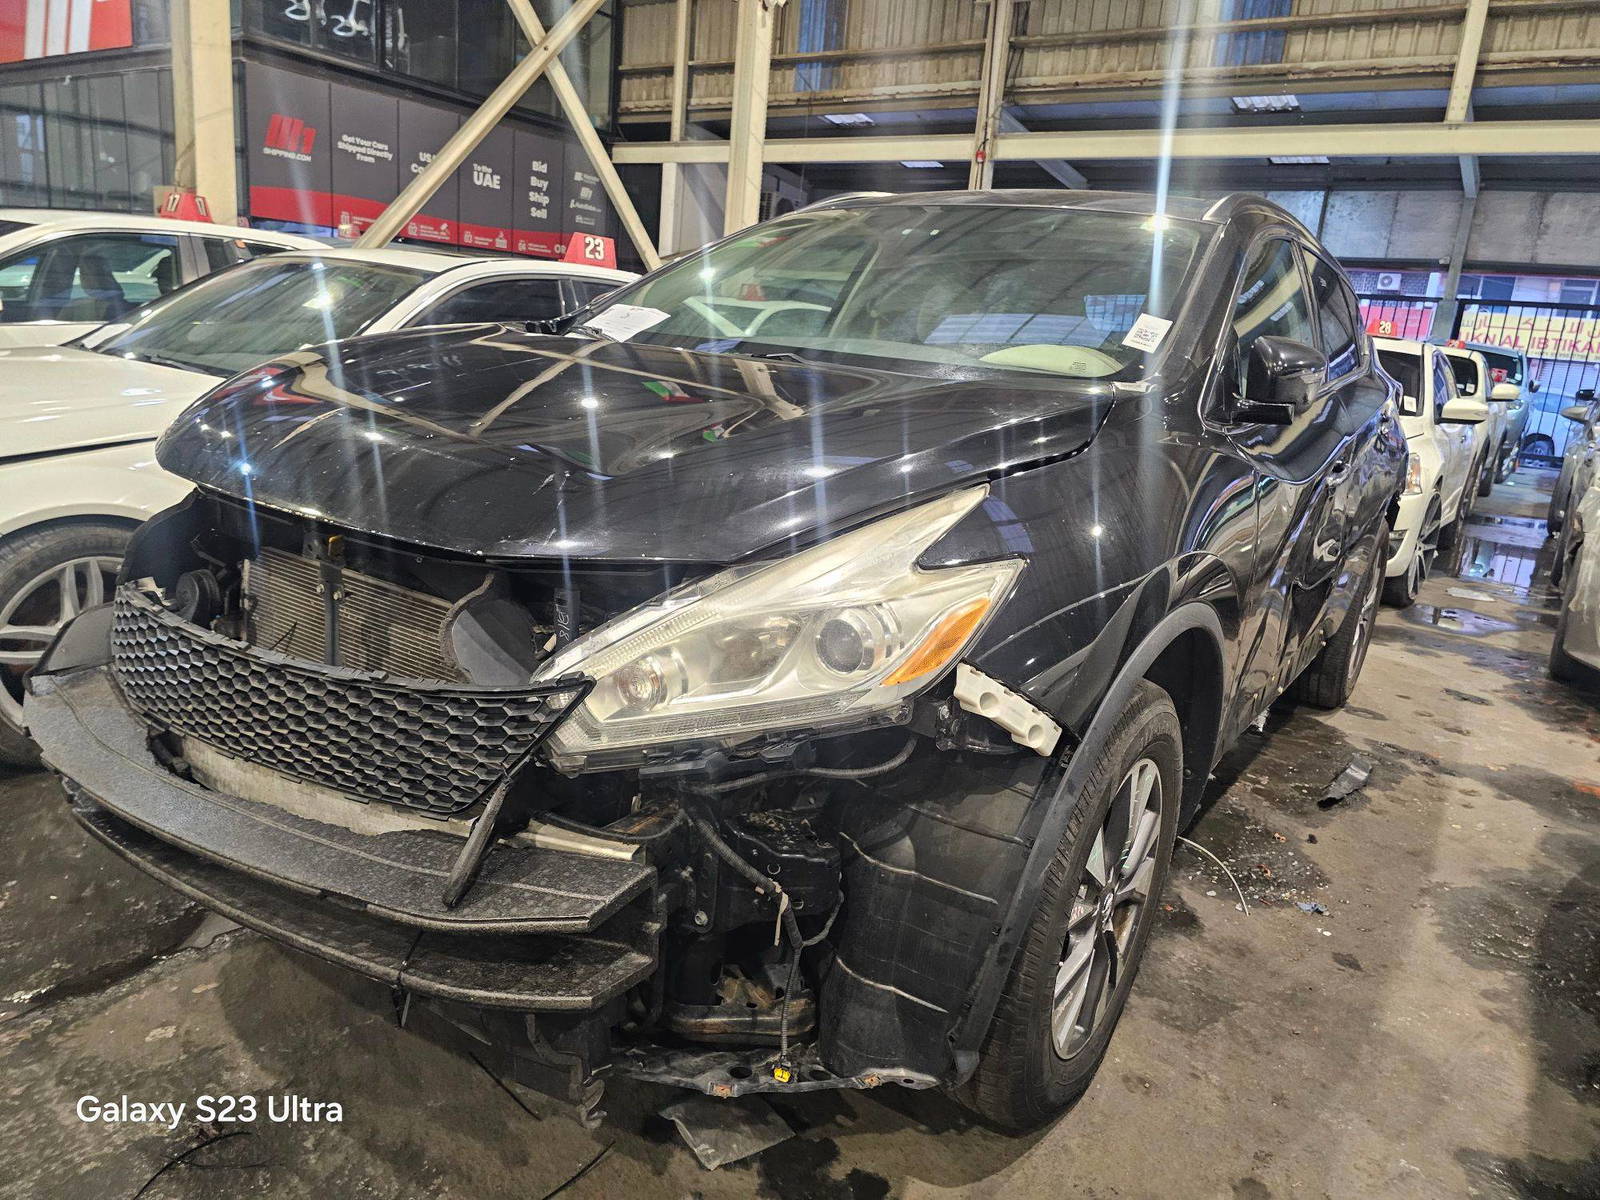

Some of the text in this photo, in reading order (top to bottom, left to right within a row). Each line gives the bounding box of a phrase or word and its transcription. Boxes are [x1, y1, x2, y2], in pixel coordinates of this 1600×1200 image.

[532, 160, 548, 174] Bid
[473, 170, 501, 190] UAE
[530, 175, 549, 192] Buy
[528, 191, 550, 207] Ship
[530, 207, 548, 219] Sell
[584, 236, 604, 260] 23
[1379, 320, 1392, 334] 28
